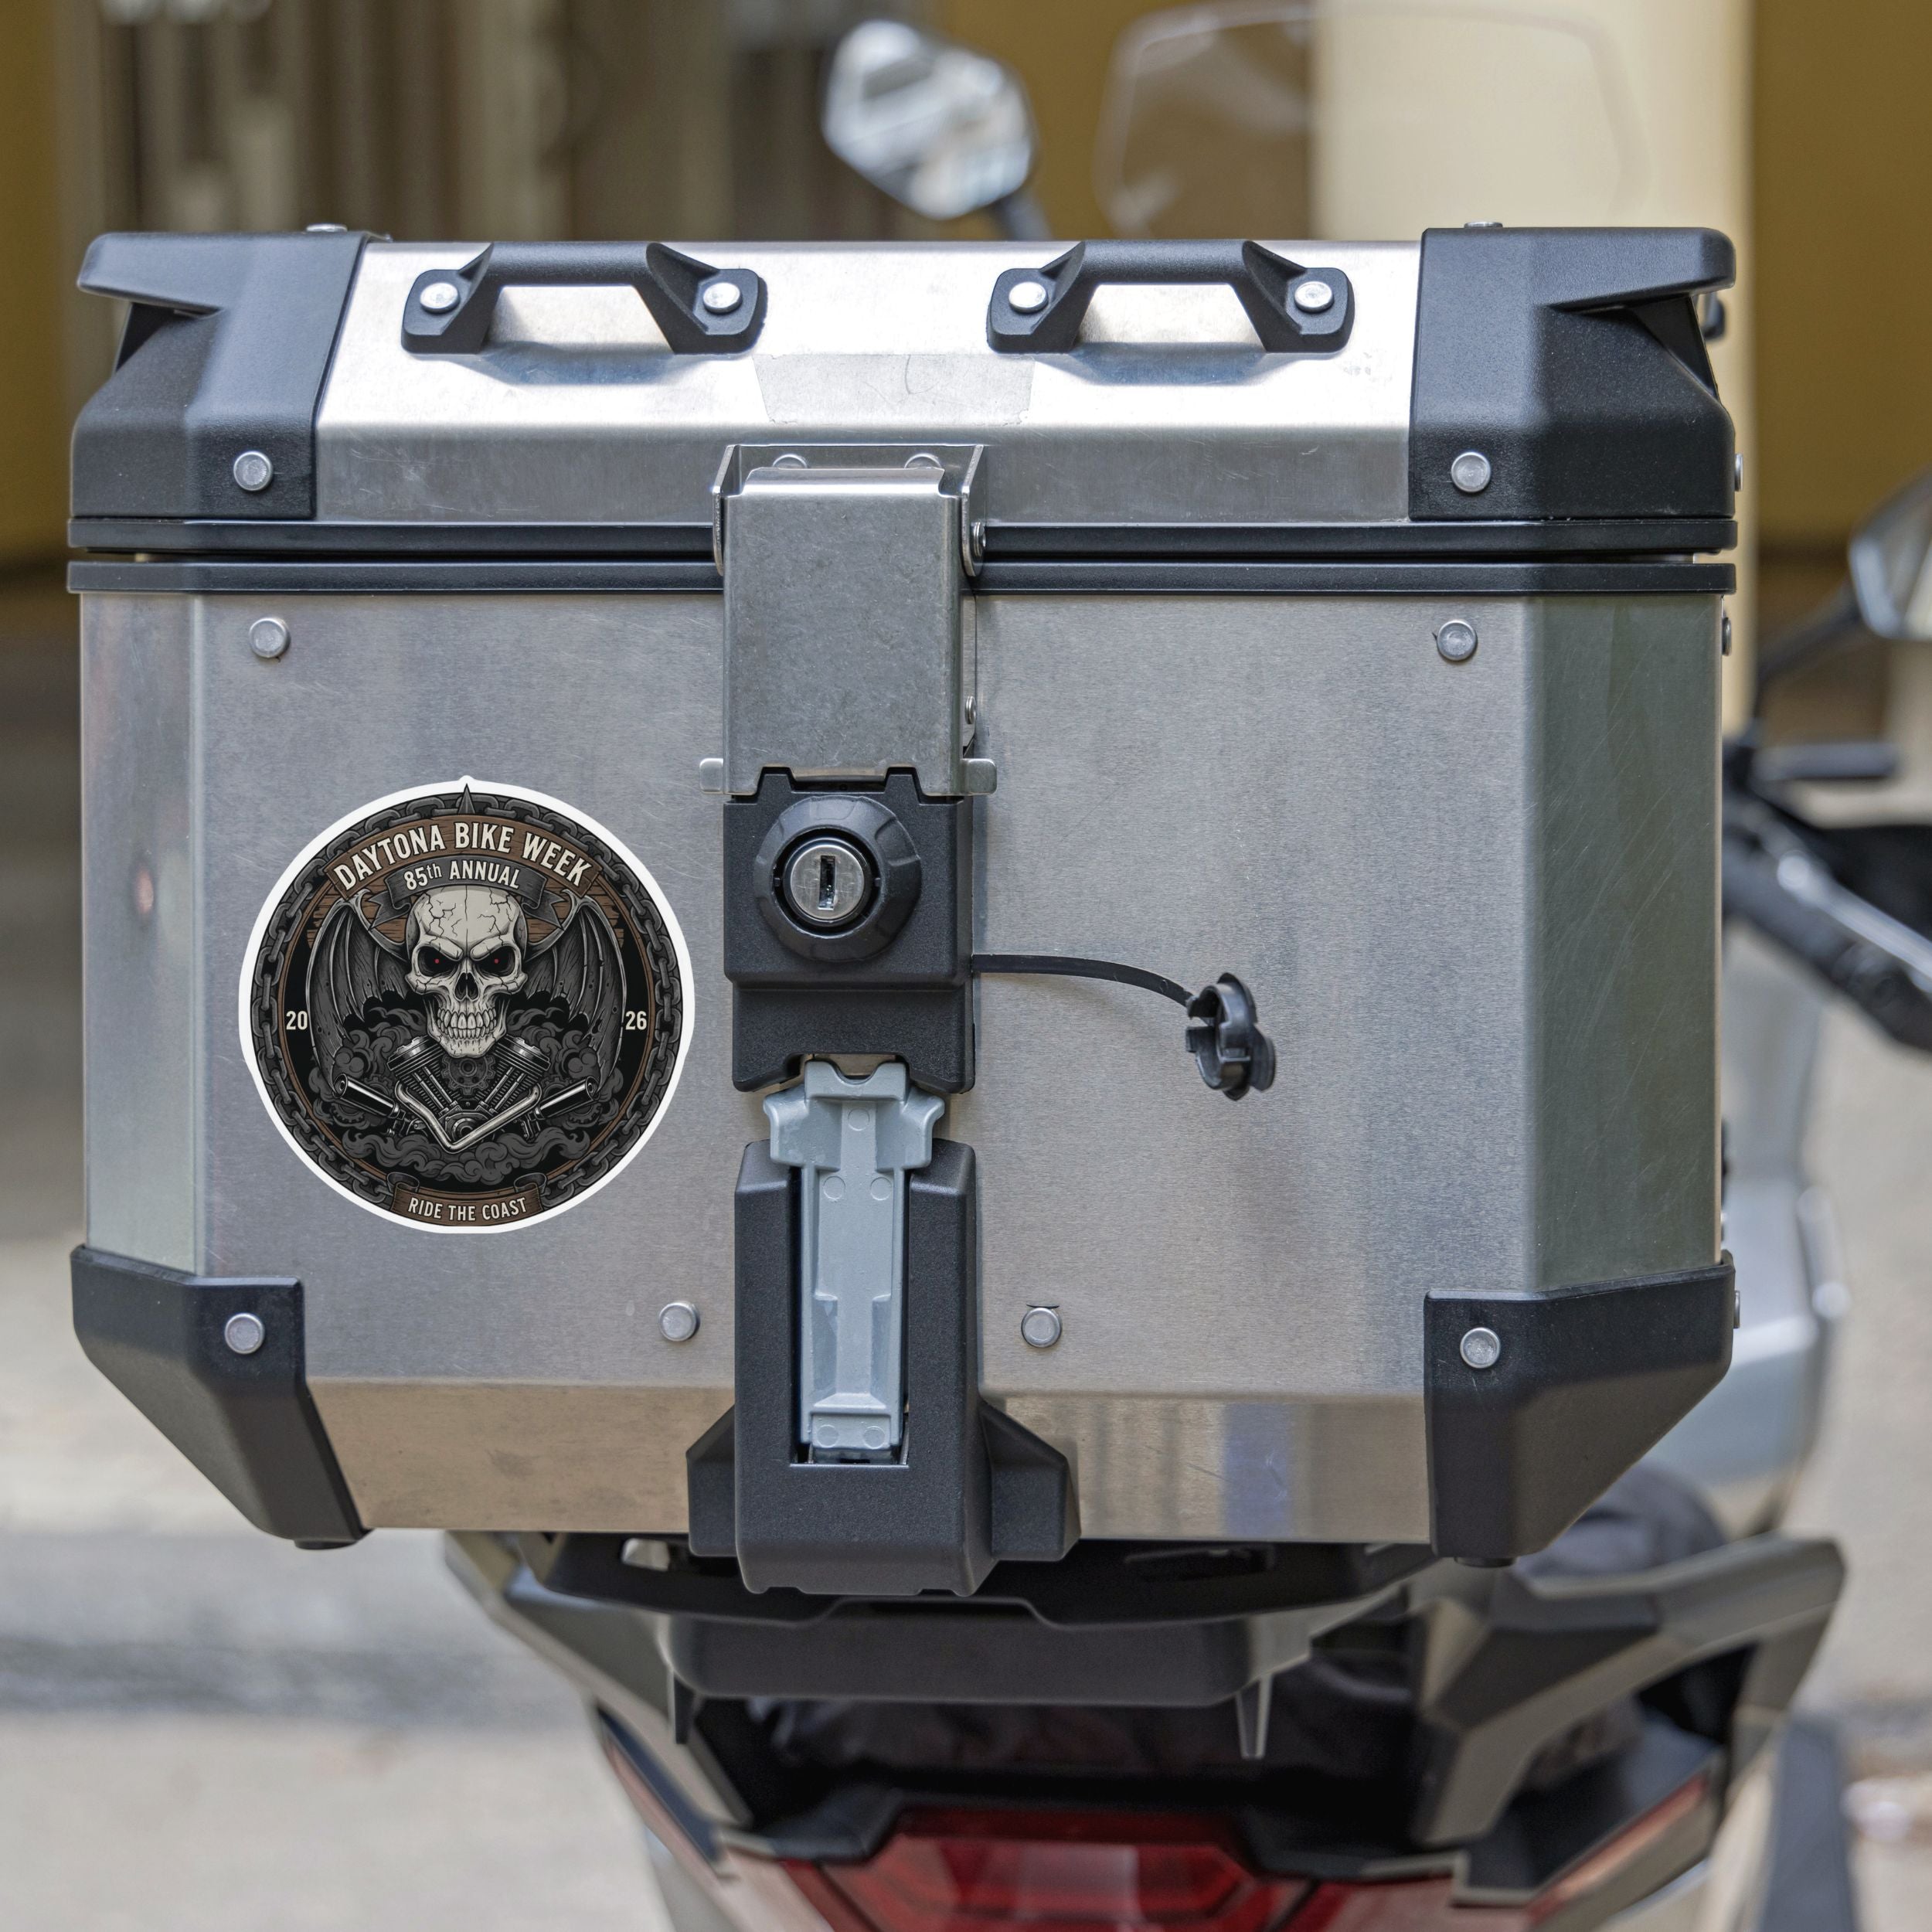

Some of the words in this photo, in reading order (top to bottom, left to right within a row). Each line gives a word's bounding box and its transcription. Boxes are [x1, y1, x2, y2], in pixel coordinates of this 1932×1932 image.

[334, 824, 446, 890] DAYTONA
[454, 822, 515, 853] BIKE
[522, 832, 592, 887] WEEK
[403, 863, 443, 890] 85th
[449, 860, 519, 889] ANNUAL
[286, 1010, 308, 1030] 20
[625, 1010, 648, 1030] 26
[408, 1197, 443, 1219] RIDE
[448, 1205, 476, 1221] THE
[481, 1197, 527, 1220] COAST
